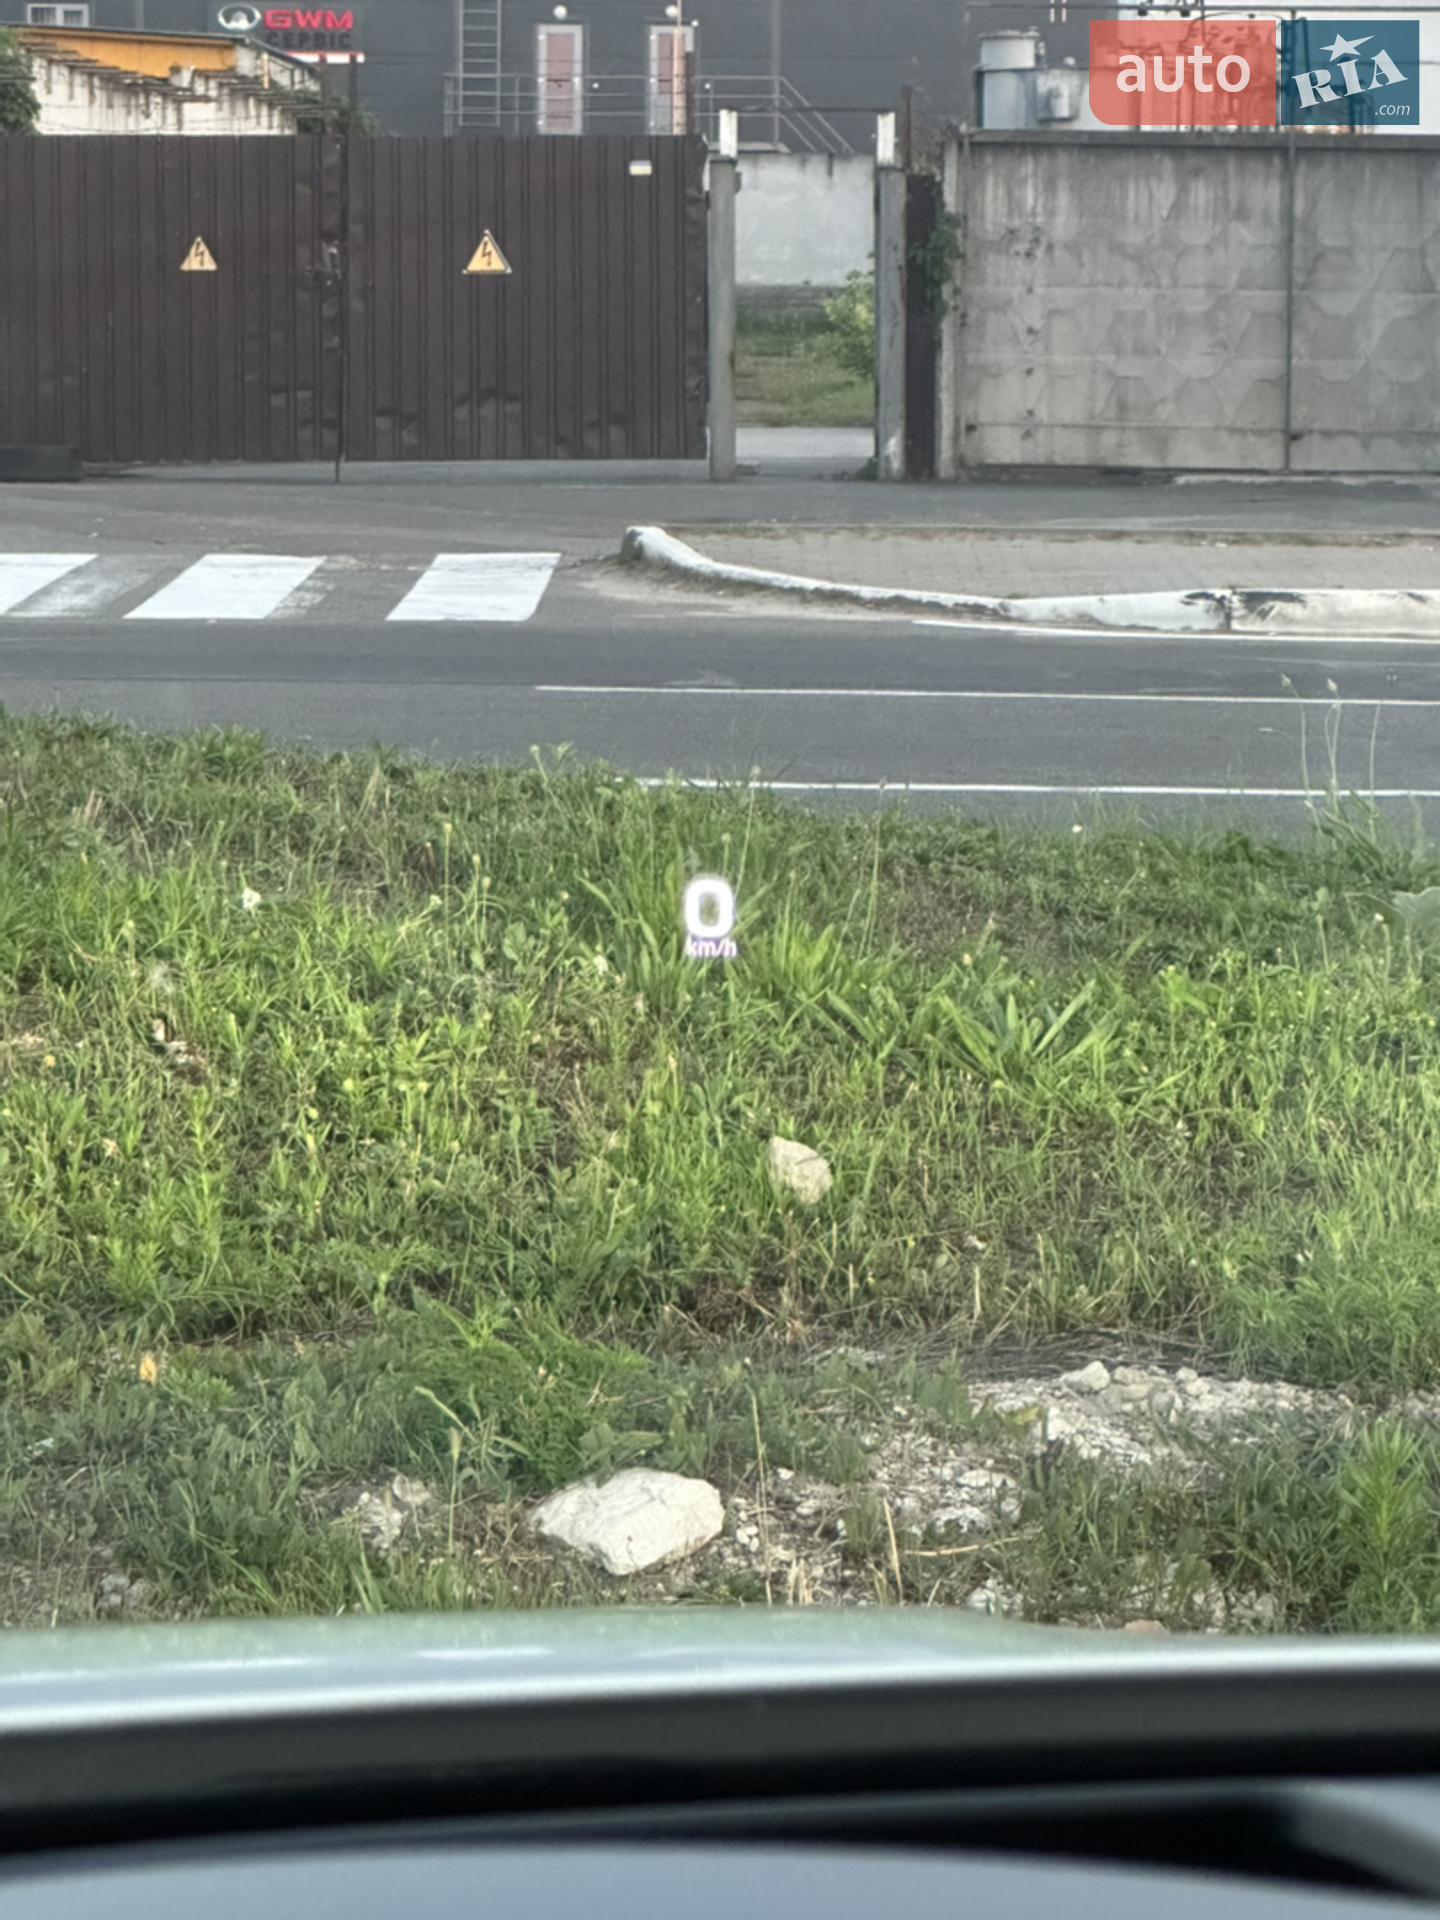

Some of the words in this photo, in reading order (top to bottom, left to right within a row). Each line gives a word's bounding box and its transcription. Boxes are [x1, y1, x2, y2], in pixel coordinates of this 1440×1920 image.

[265, 10, 353, 29] GWM
[684, 877, 734, 938] 0
[686, 935, 737, 957] km/h
